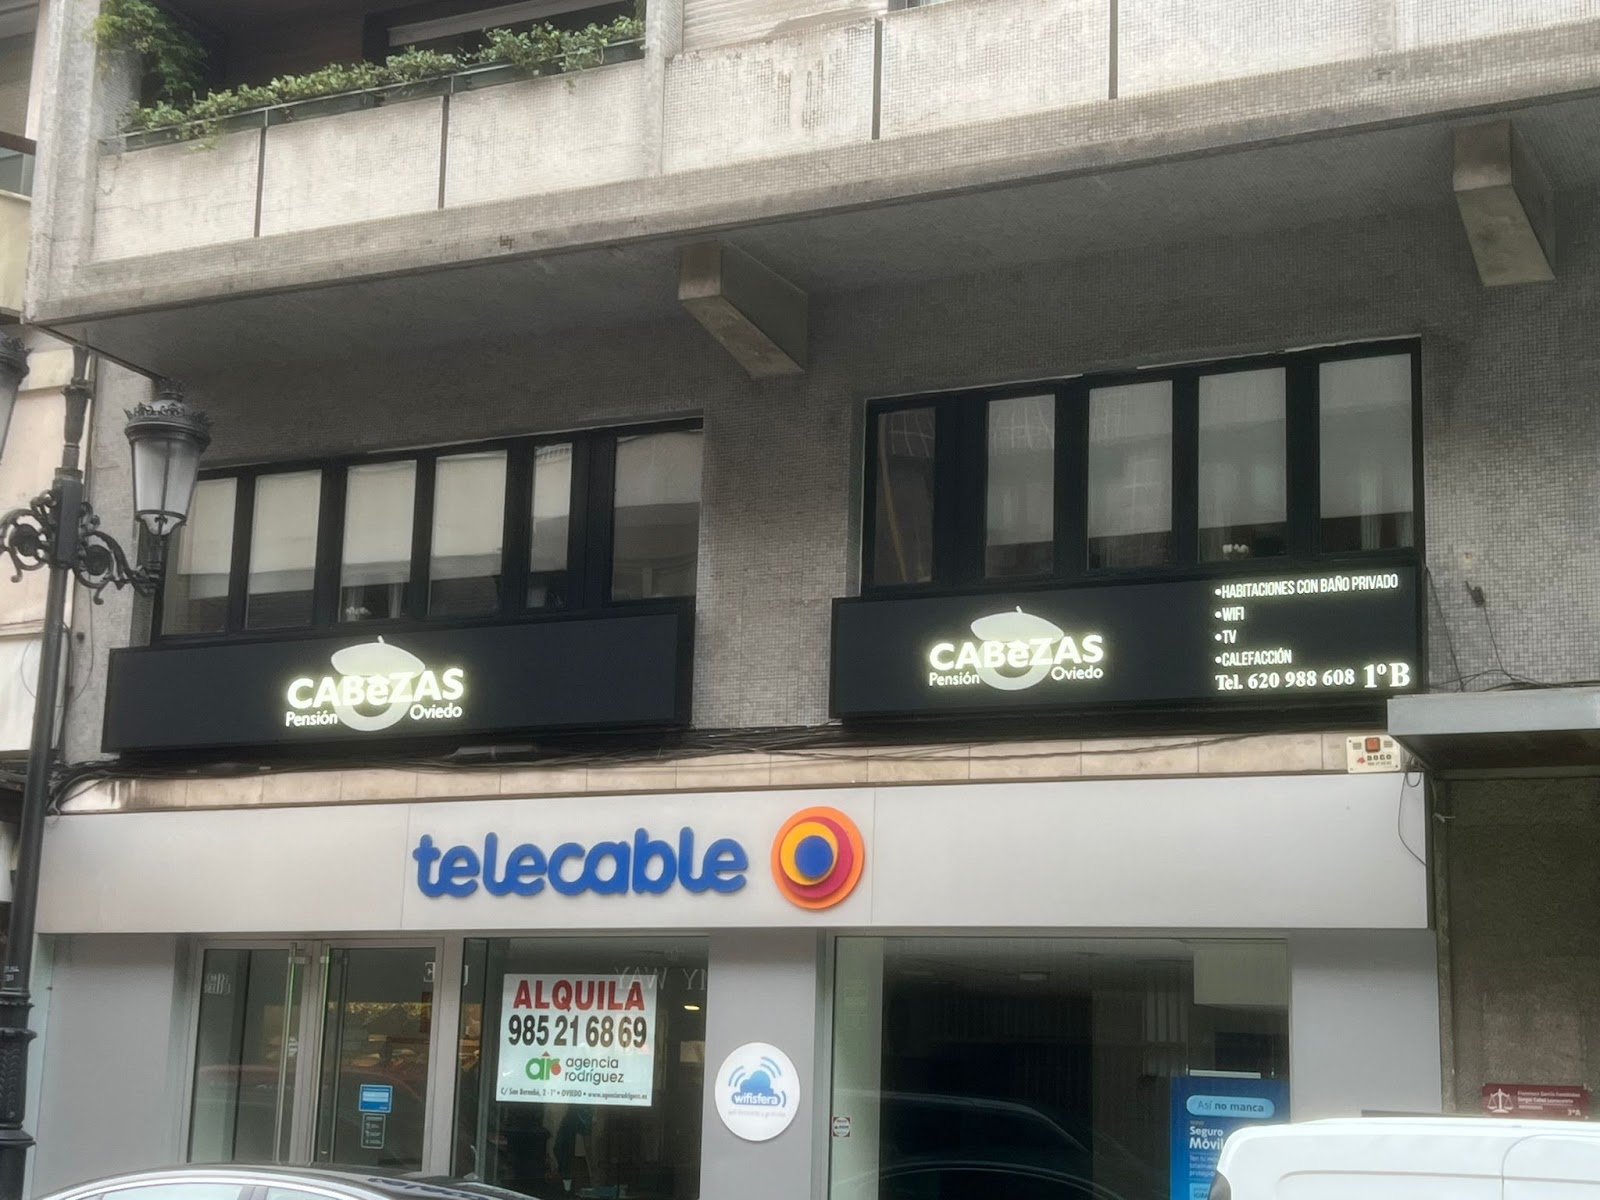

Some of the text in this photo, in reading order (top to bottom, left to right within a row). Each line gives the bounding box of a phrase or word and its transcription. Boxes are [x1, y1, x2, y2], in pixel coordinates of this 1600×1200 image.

[1221, 573, 1399, 599] HABITACIONES CON BAÑO PRIVADO
[1222, 606, 1244, 621] WIFI
[1222, 629, 1237, 644] TV
[1222, 647, 1292, 667] CALEFACCIÓN
[929, 671, 980, 687] Pensión
[1051, 665, 1103, 681] Oviedo
[1215, 674, 1243, 690] Tel.
[1247, 672, 1280, 689] 620
[1284, 670, 1317, 687] 988
[1322, 668, 1355, 686] 608
[285, 710, 338, 728] Pensión
[410, 703, 462, 720] Oviedo
[412, 826, 749, 898] telecable
[513, 979, 645, 1012] ALQUILA
[508, 1014, 550, 1046] 985
[553, 1014, 579, 1047] 21
[585, 1015, 614, 1048] 68
[565, 1056, 619, 1070] agencia
[564, 1068, 624, 1085] rodríguez
[561, 1089, 582, 1097] OVIEDO
[734, 1092, 778, 1105] wifisfera
[1198, 1099, 1212, 1108] Así
[1230, 1103, 1264, 1112] manca
[1189, 1126, 1224, 1138] Seguro
[1189, 1138, 1224, 1150] Móvil
